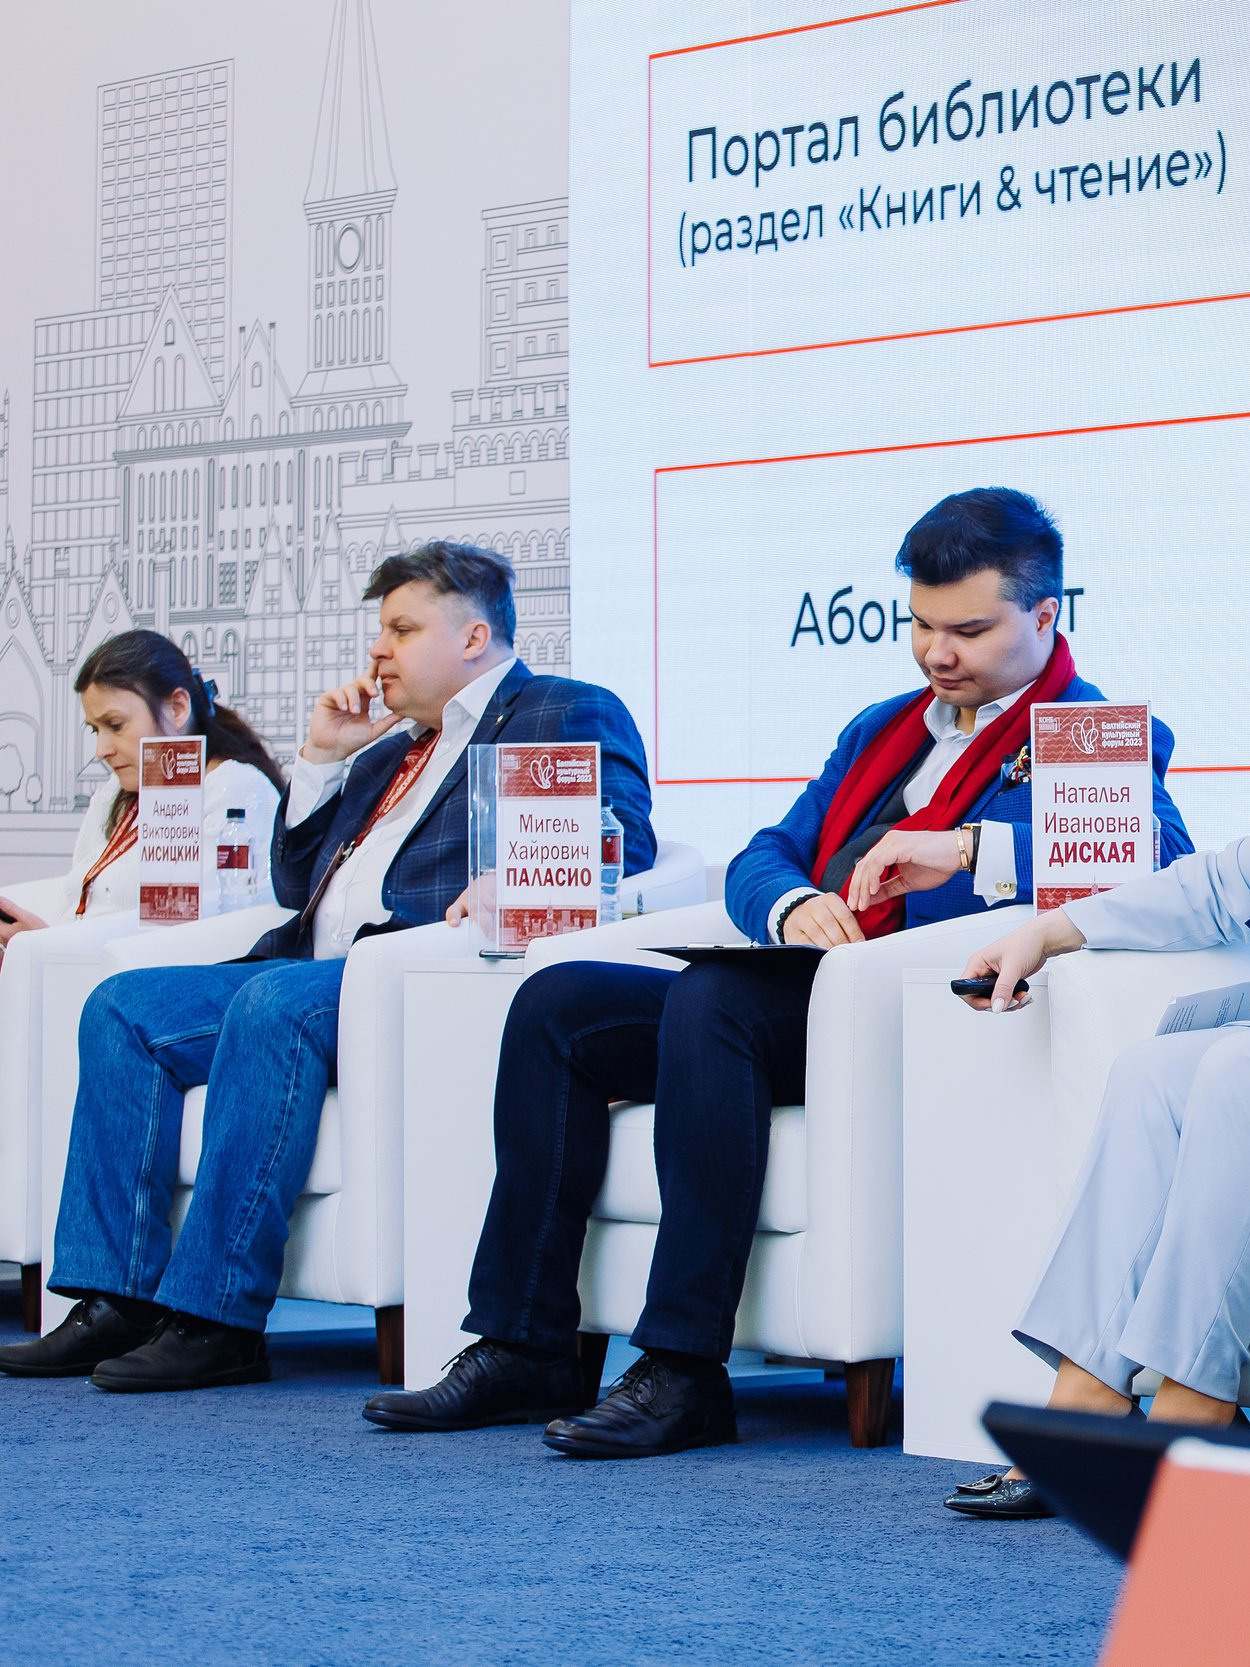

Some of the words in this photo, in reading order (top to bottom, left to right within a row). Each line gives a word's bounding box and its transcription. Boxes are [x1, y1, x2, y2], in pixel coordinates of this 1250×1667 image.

[688, 114, 860, 188] Портал
[879, 57, 1202, 152] библиотеки
[679, 203, 824, 268] (раздел
[838, 179, 982, 231] «Книги
[996, 165, 1022, 212] &
[1033, 129, 1228, 207] чтение»)
[1053, 782, 1131, 804] Наталья
[152, 799, 190, 821] Андрей
[142, 823, 200, 845] Викторович
[519, 813, 580, 834] Мигель
[1044, 811, 1141, 835] Ивановна
[140, 840, 200, 864] ЛИСИЦКИЙ
[507, 839, 590, 865] Хайрович
[1048, 841, 1136, 868] ДИСКАЯ
[505, 867, 593, 888] ПАЛАСИО
